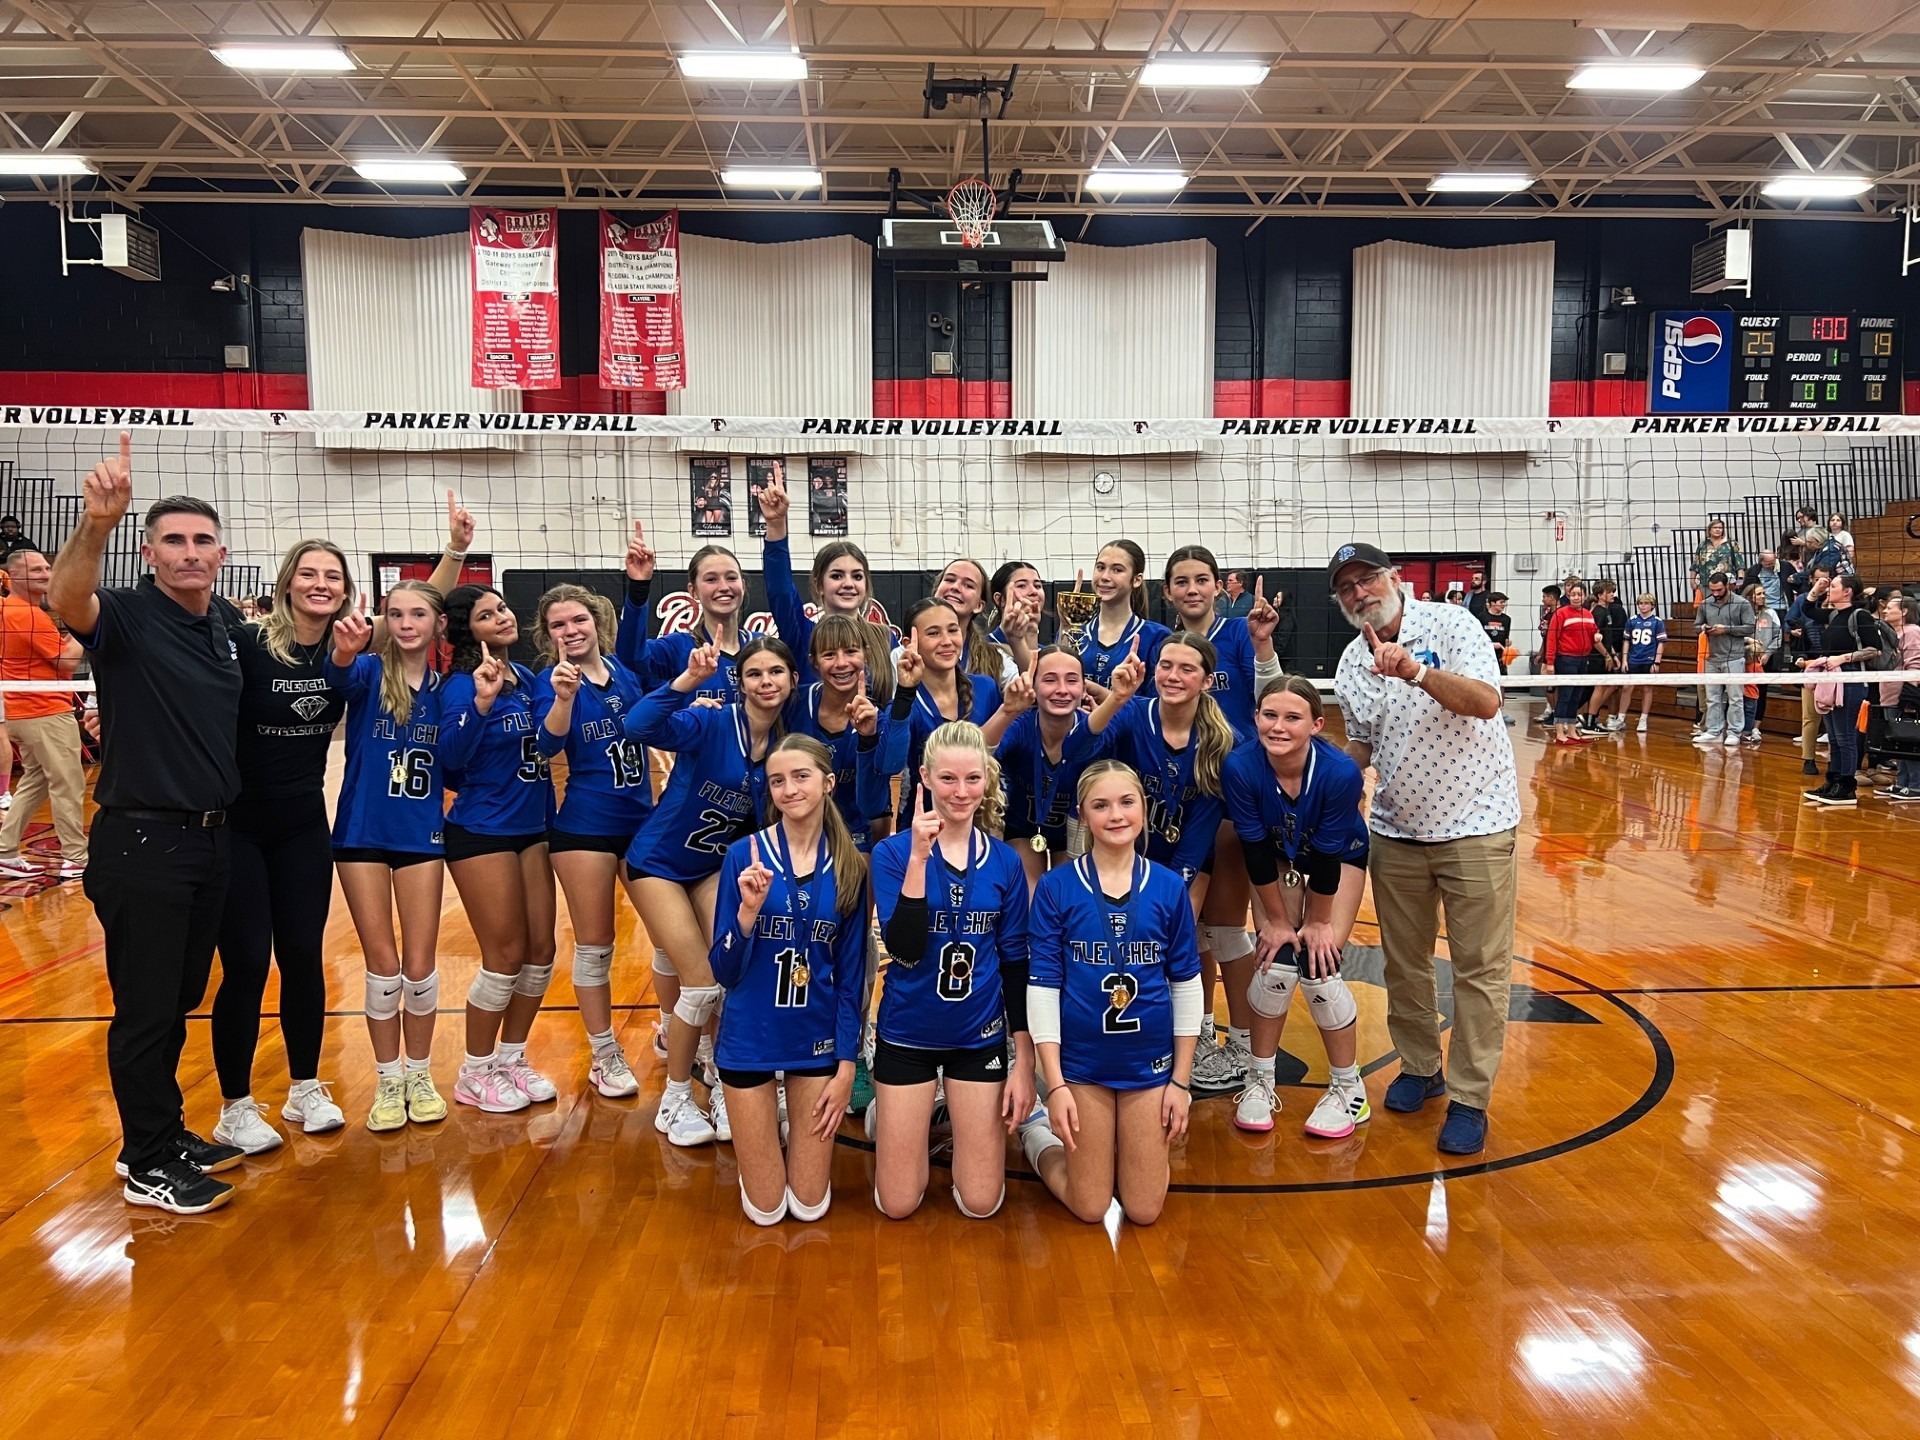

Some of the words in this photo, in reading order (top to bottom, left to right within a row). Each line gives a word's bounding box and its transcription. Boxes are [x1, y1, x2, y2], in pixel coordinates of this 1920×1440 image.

[507, 213, 549, 231] BRAVES
[1740, 316, 1780, 328] GUEST
[1812, 316, 1849, 341] 1:00
[1860, 317, 1895, 329] HOME
[1746, 331, 1775, 355] 25
[1874, 331, 1893, 357] 19
[1662, 318, 1684, 400] PEPSI
[1786, 352, 1822, 362] PERIOD
[1744, 373, 1769, 381] FOULS
[1790, 373, 1842, 381] PLAYER-FOUL
[1742, 401, 1769, 409] POINTS
[1789, 401, 1817, 409] MATCH
[29, 407, 195, 427] VOLLEYBALL
[363, 412, 470, 430] PARKER
[478, 413, 638, 432] VOLLEYBALL
[1629, 417, 1730, 434] PARKER
[1737, 415, 1882, 433] VOLLEYBALL
[799, 418, 903, 436] PARKER
[910, 419, 1063, 436] VOLLEYBALL
[1219, 419, 1322, 435] PARKER
[1328, 418, 1478, 435] VOLLEYBALL
[693, 459, 728, 467] BRAVES
[1521, 557, 1536, 568] EXIT
[1631, 628, 1653, 645] 96
[516, 734, 549, 783] 5
[605, 738, 644, 789] 19
[387, 748, 434, 800] 16
[774, 946, 810, 1008] 11
[936, 941, 977, 1002] 8
[1101, 972, 1141, 1034] 2
